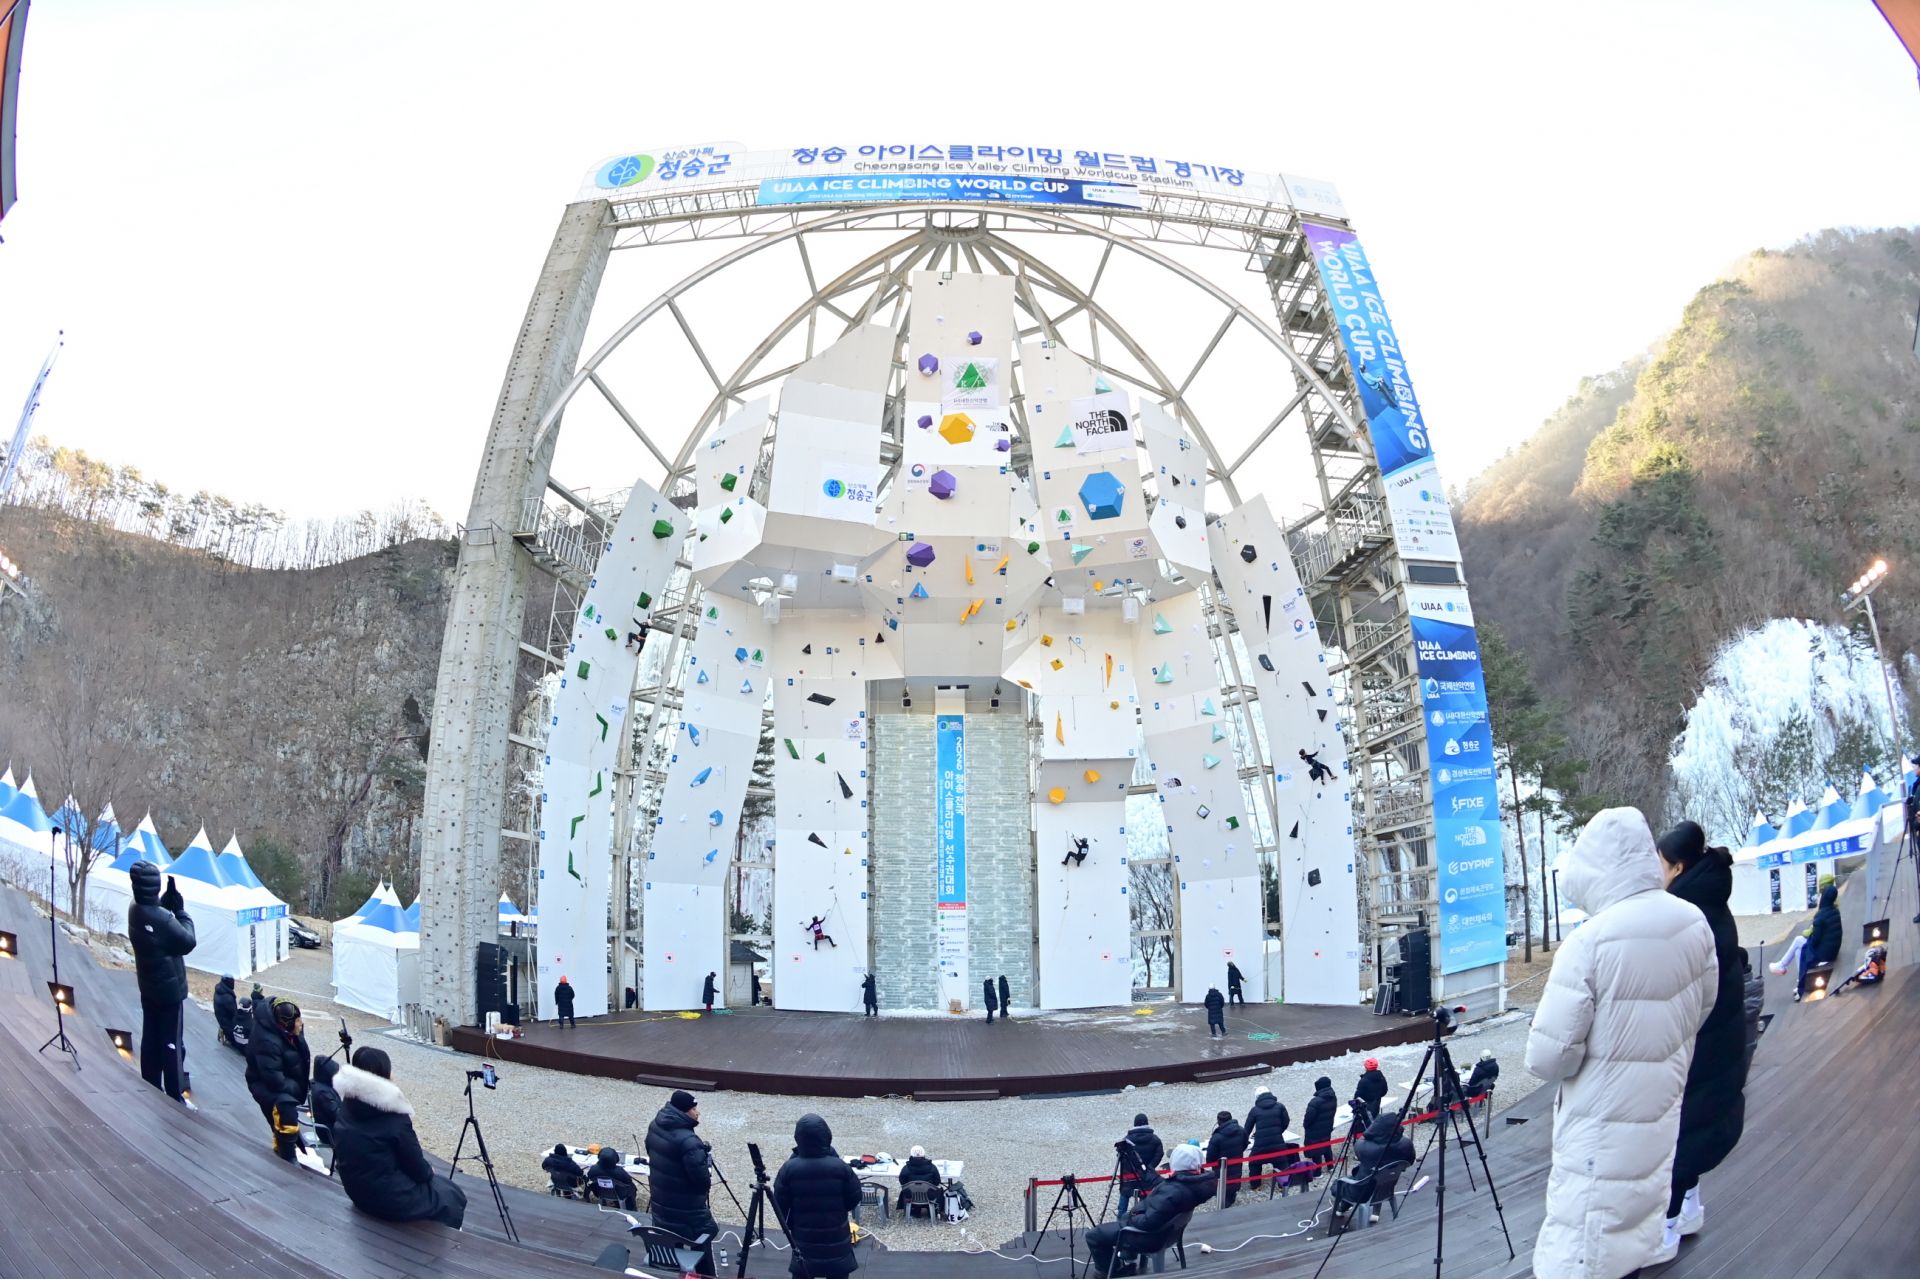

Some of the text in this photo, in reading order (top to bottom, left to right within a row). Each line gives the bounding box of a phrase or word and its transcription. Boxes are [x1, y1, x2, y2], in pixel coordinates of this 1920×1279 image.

[656, 154, 732, 180] 청송군
[791, 144, 1245, 186] 청송 아이스클라이밍 월드컵 경기장
[853, 161, 1194, 188] Cheongsong Ice Valley Climbing Worldcup Stadium
[773, 177, 1070, 193] UIAA ICE CLIMBING WORLD CUP
[1316, 239, 1359, 312] WORLD
[1345, 313, 1377, 366] CUP
[1339, 242, 1427, 450] UIAA ICE CLIMBING
[1088, 410, 1108, 420] THE
[1075, 418, 1110, 430] NORTH
[1086, 426, 1111, 437] FACE
[846, 488, 873, 503] 청송군
[1420, 602, 1443, 611] UIAA
[1417, 640, 1441, 650] UIAA
[1419, 650, 1477, 661] ICE CLIMBING
[1458, 797, 1485, 810] FIXE
[944, 770, 955, 896] 아이스클라이밍 선수권대회
[1813, 840, 1848, 856] 시스템 운영
[1460, 857, 1495, 872] DYPNF
